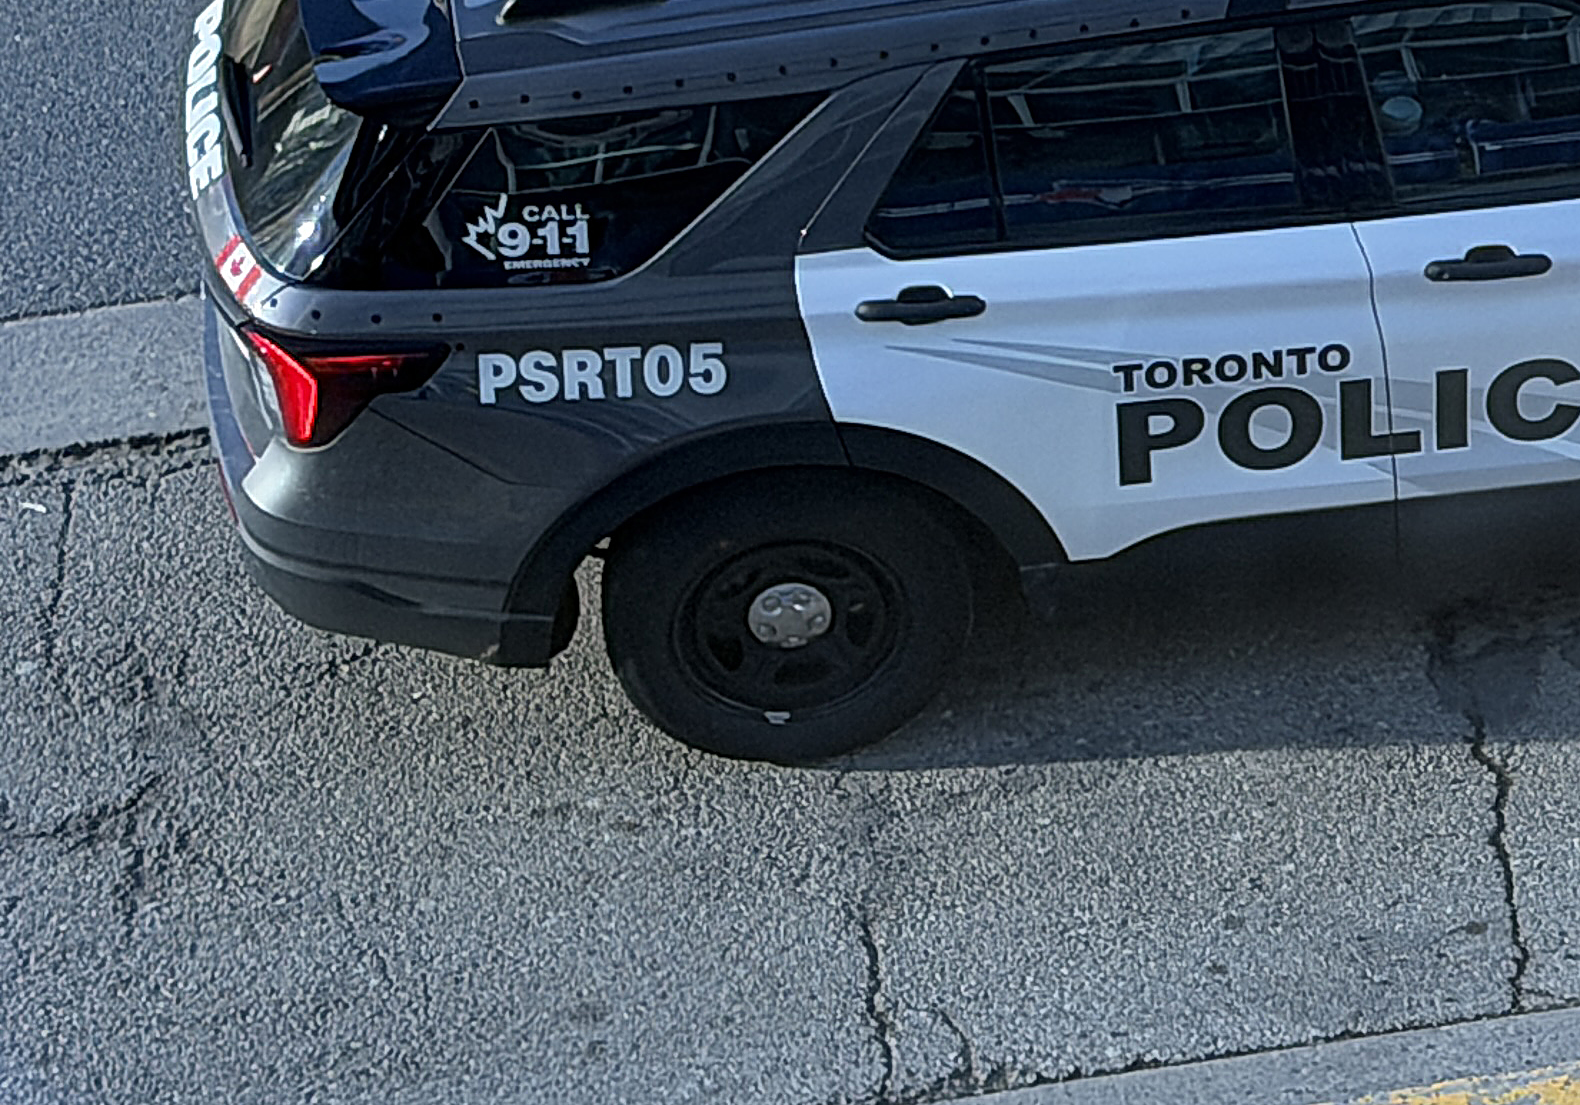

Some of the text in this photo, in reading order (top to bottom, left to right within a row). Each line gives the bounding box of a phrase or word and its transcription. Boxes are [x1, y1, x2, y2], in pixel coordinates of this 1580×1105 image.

[521, 203, 590, 223] CALL
[503, 257, 591, 271] EMERGENCY
[478, 341, 727, 405] PSRT05
[1113, 343, 1351, 393] TORONTO
